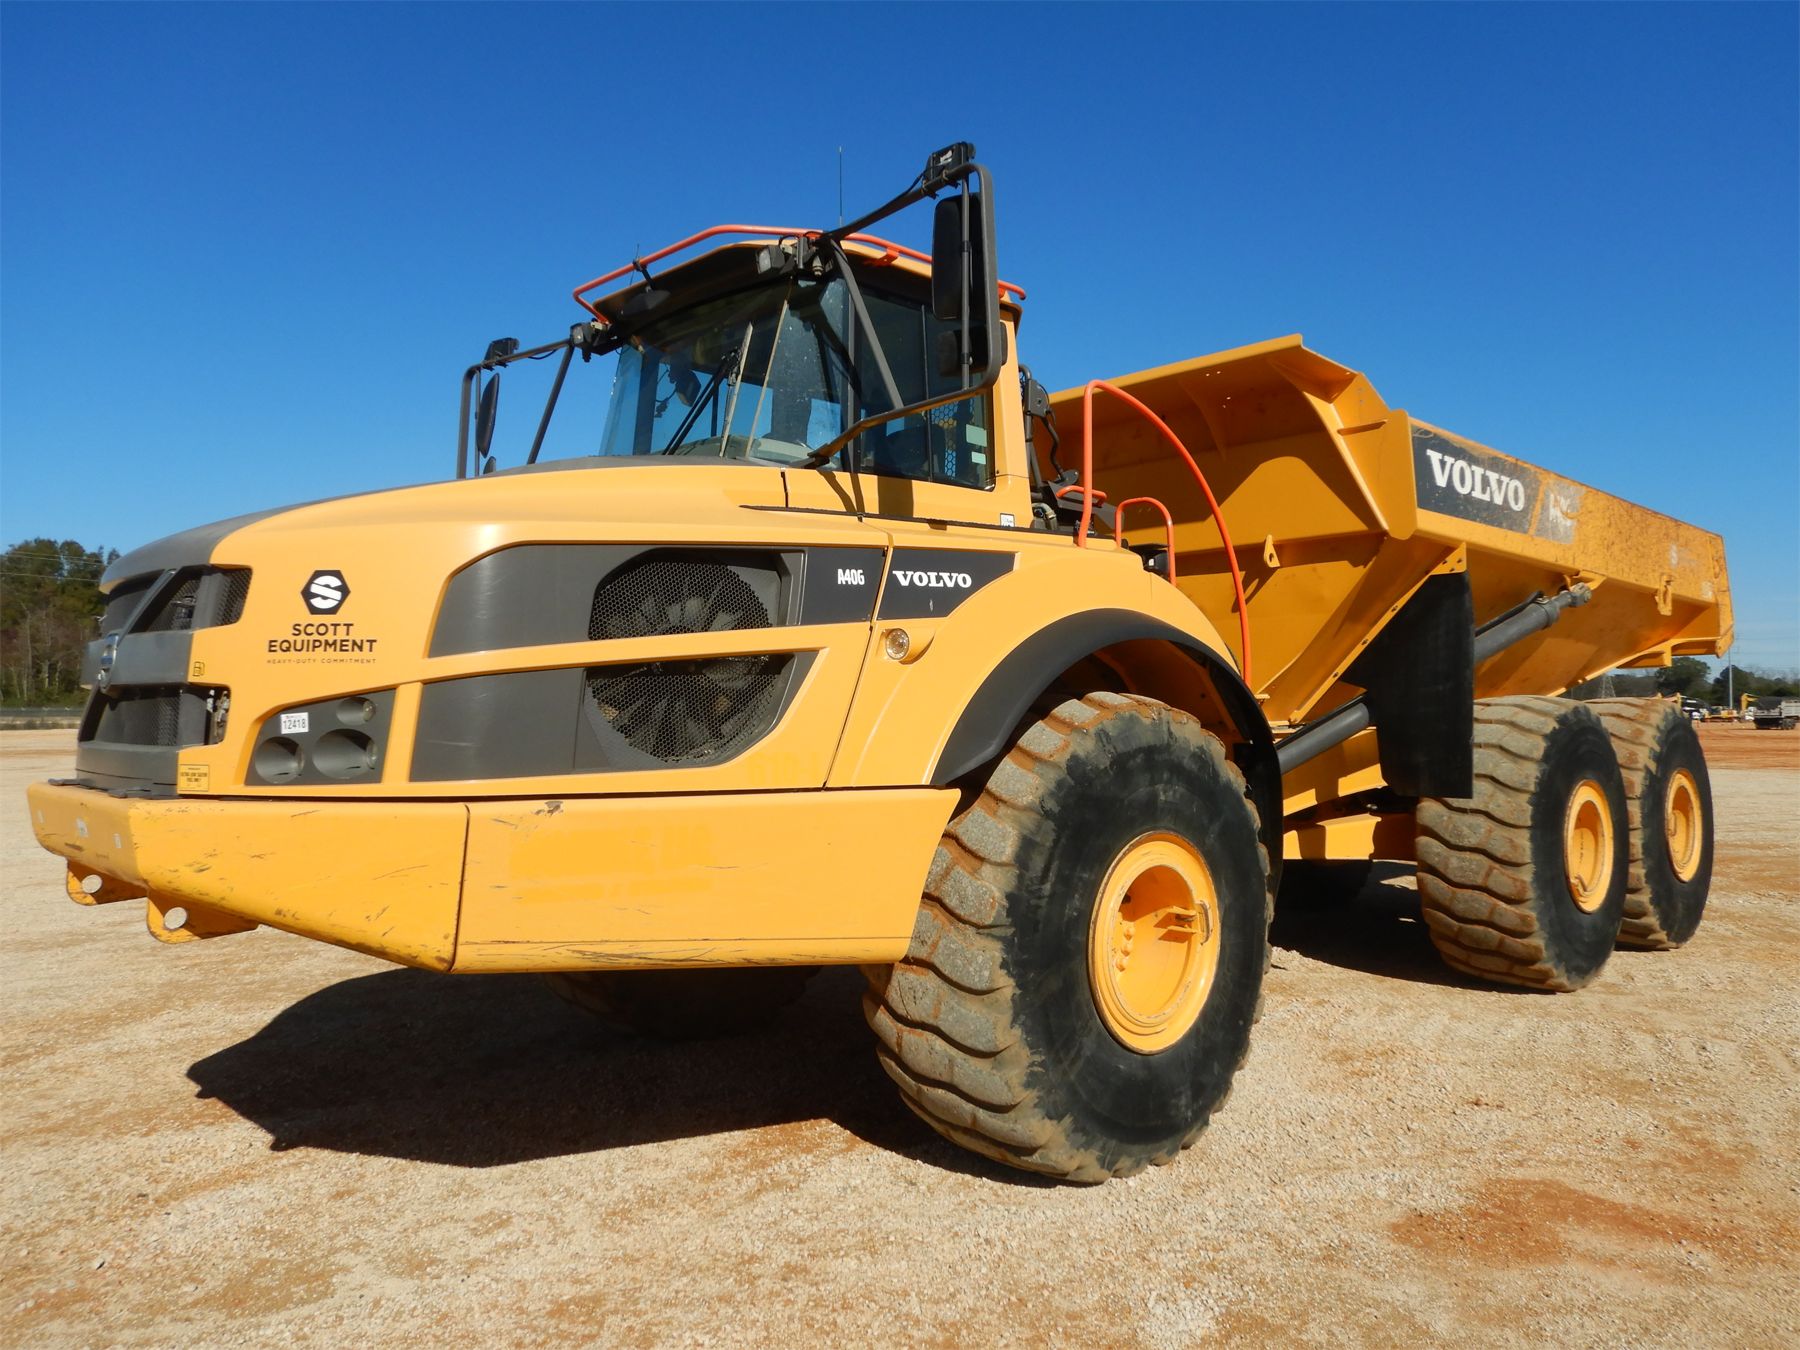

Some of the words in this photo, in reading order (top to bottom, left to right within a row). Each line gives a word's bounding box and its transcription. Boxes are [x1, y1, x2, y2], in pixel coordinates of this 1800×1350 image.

[1426, 449, 1525, 512] VOLVO
[892, 570, 973, 589] VOLVO
[292, 623, 354, 637] SCOTT
[268, 639, 377, 653] EQUIPMENT
[283, 718, 305, 730] 12418
